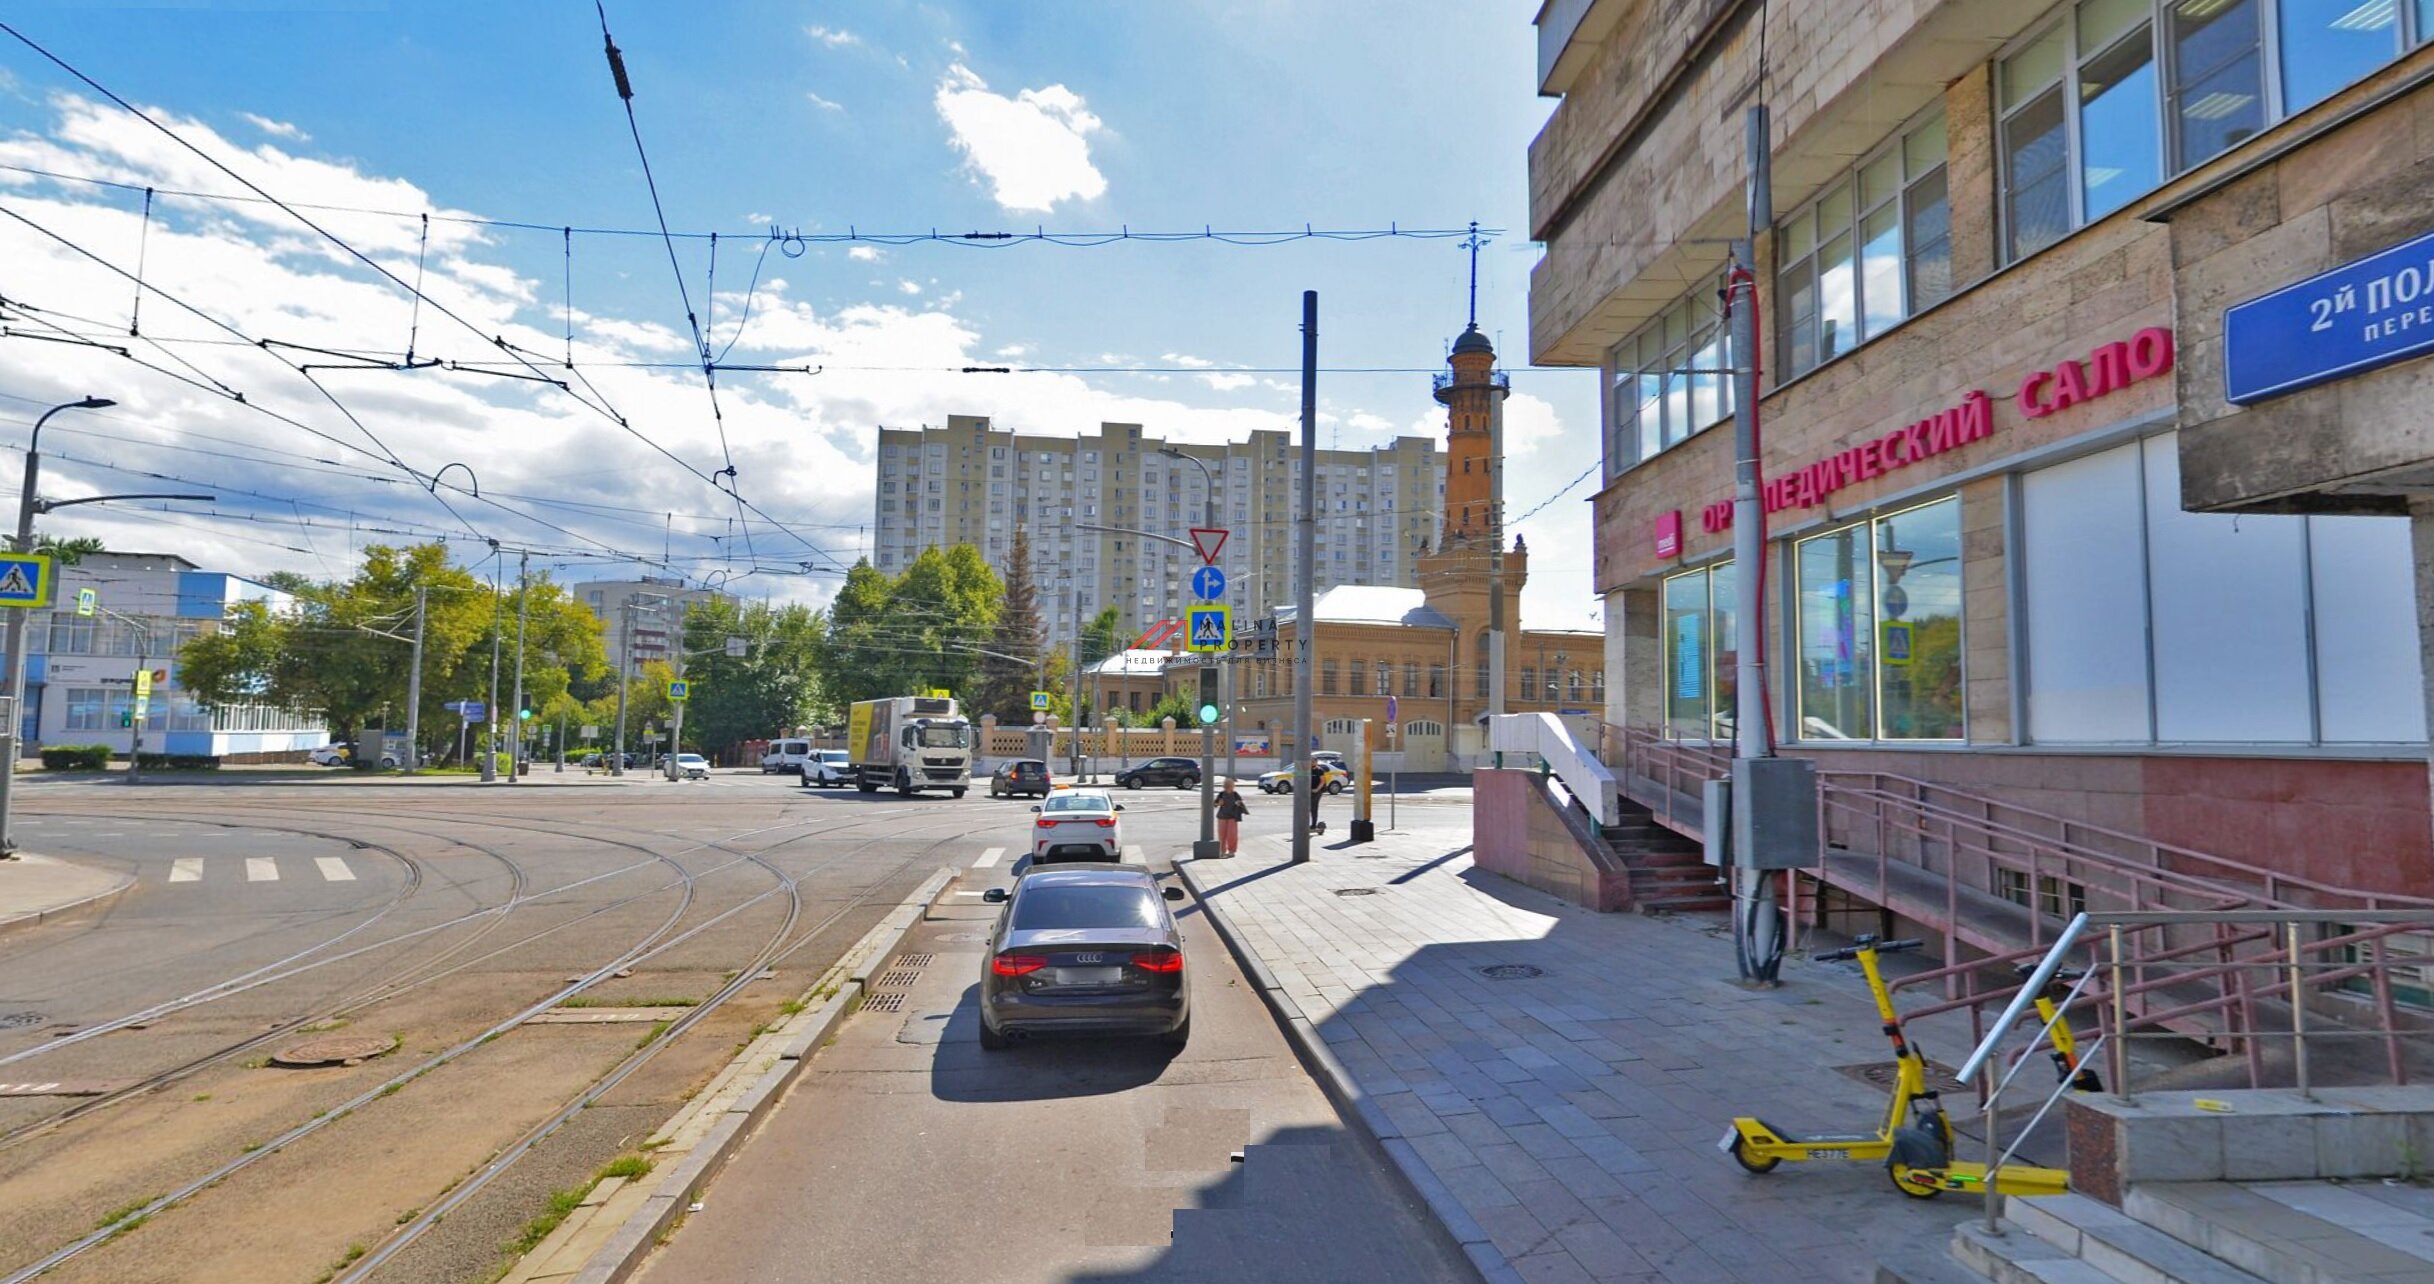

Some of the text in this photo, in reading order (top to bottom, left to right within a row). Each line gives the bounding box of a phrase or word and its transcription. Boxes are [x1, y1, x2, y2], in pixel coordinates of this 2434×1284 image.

[2364, 306, 2433, 341] ПЕРЕ
[1702, 327, 2175, 534] ОРПЕДИЧЕСКИЙ САЛО
